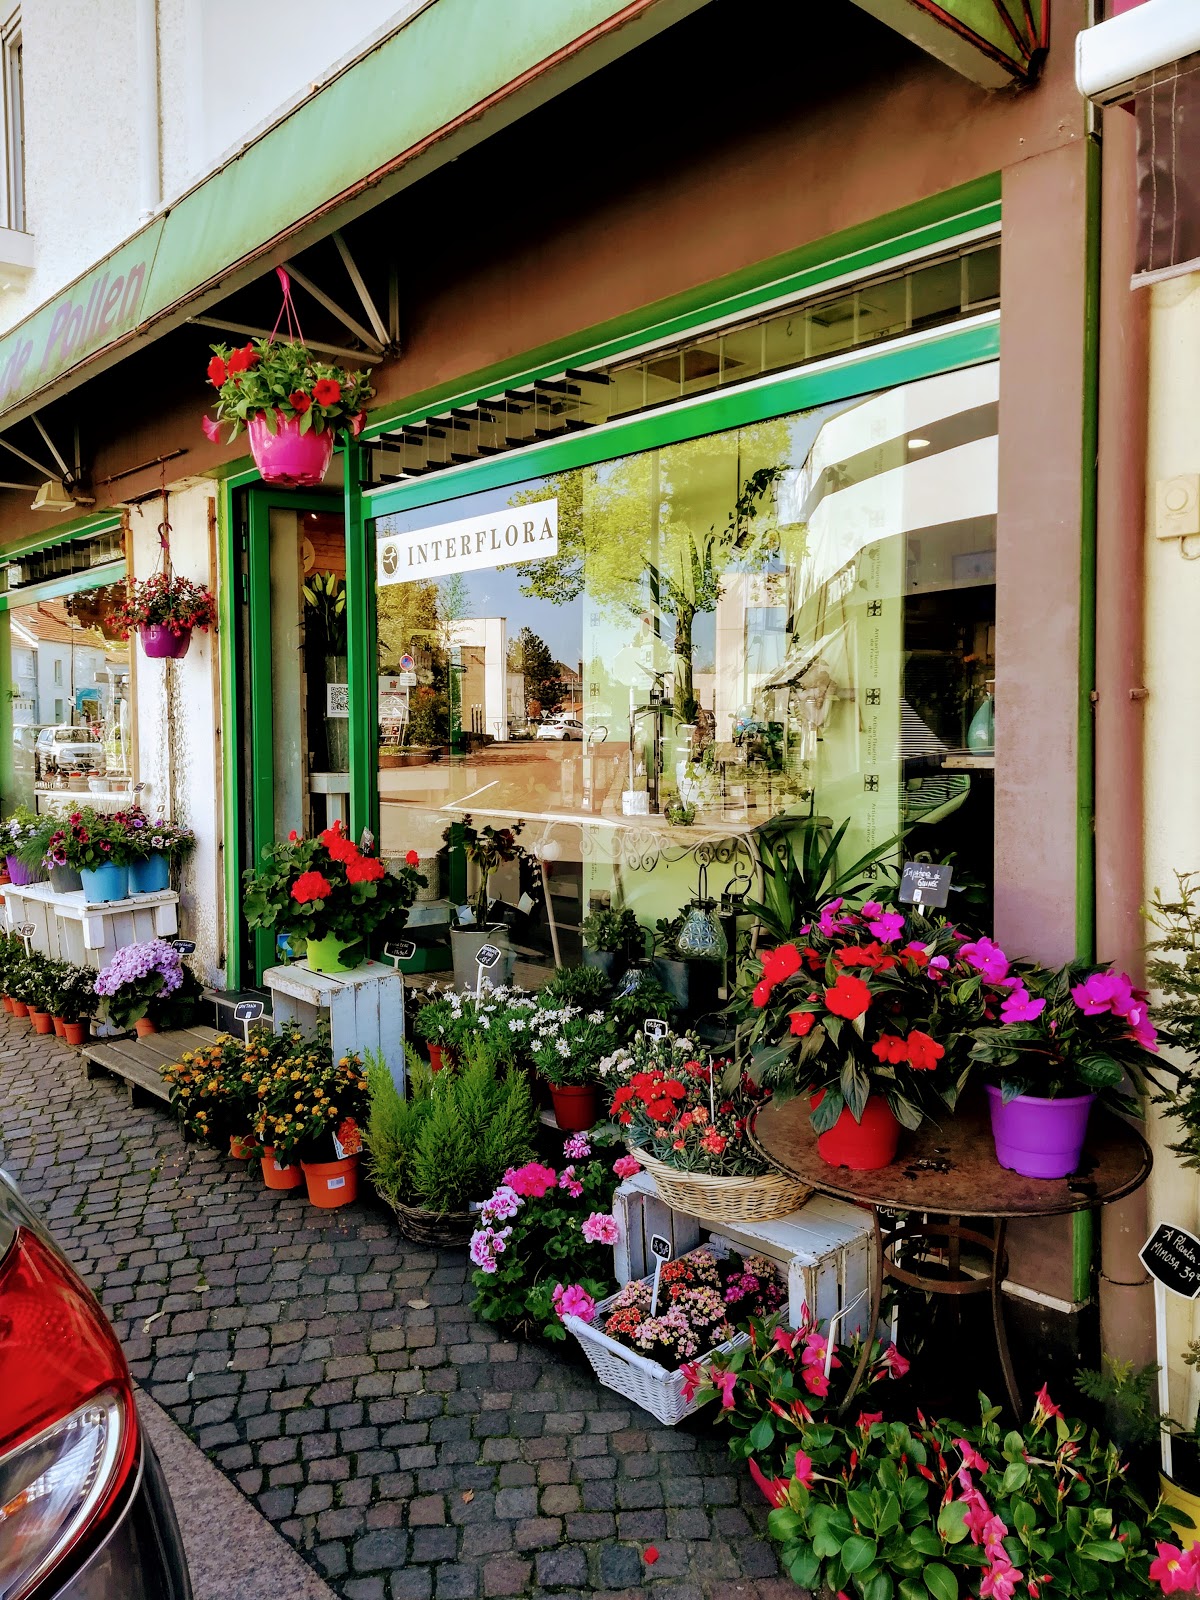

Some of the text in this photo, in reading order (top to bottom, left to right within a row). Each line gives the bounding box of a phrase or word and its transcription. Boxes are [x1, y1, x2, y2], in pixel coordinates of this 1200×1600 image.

[40, 262, 146, 374] Pollen
[407, 517, 554, 566] INTERFLORA
[1151, 1242, 1180, 1270] MIMOSA
[1173, 1235, 1195, 1263] Planter
